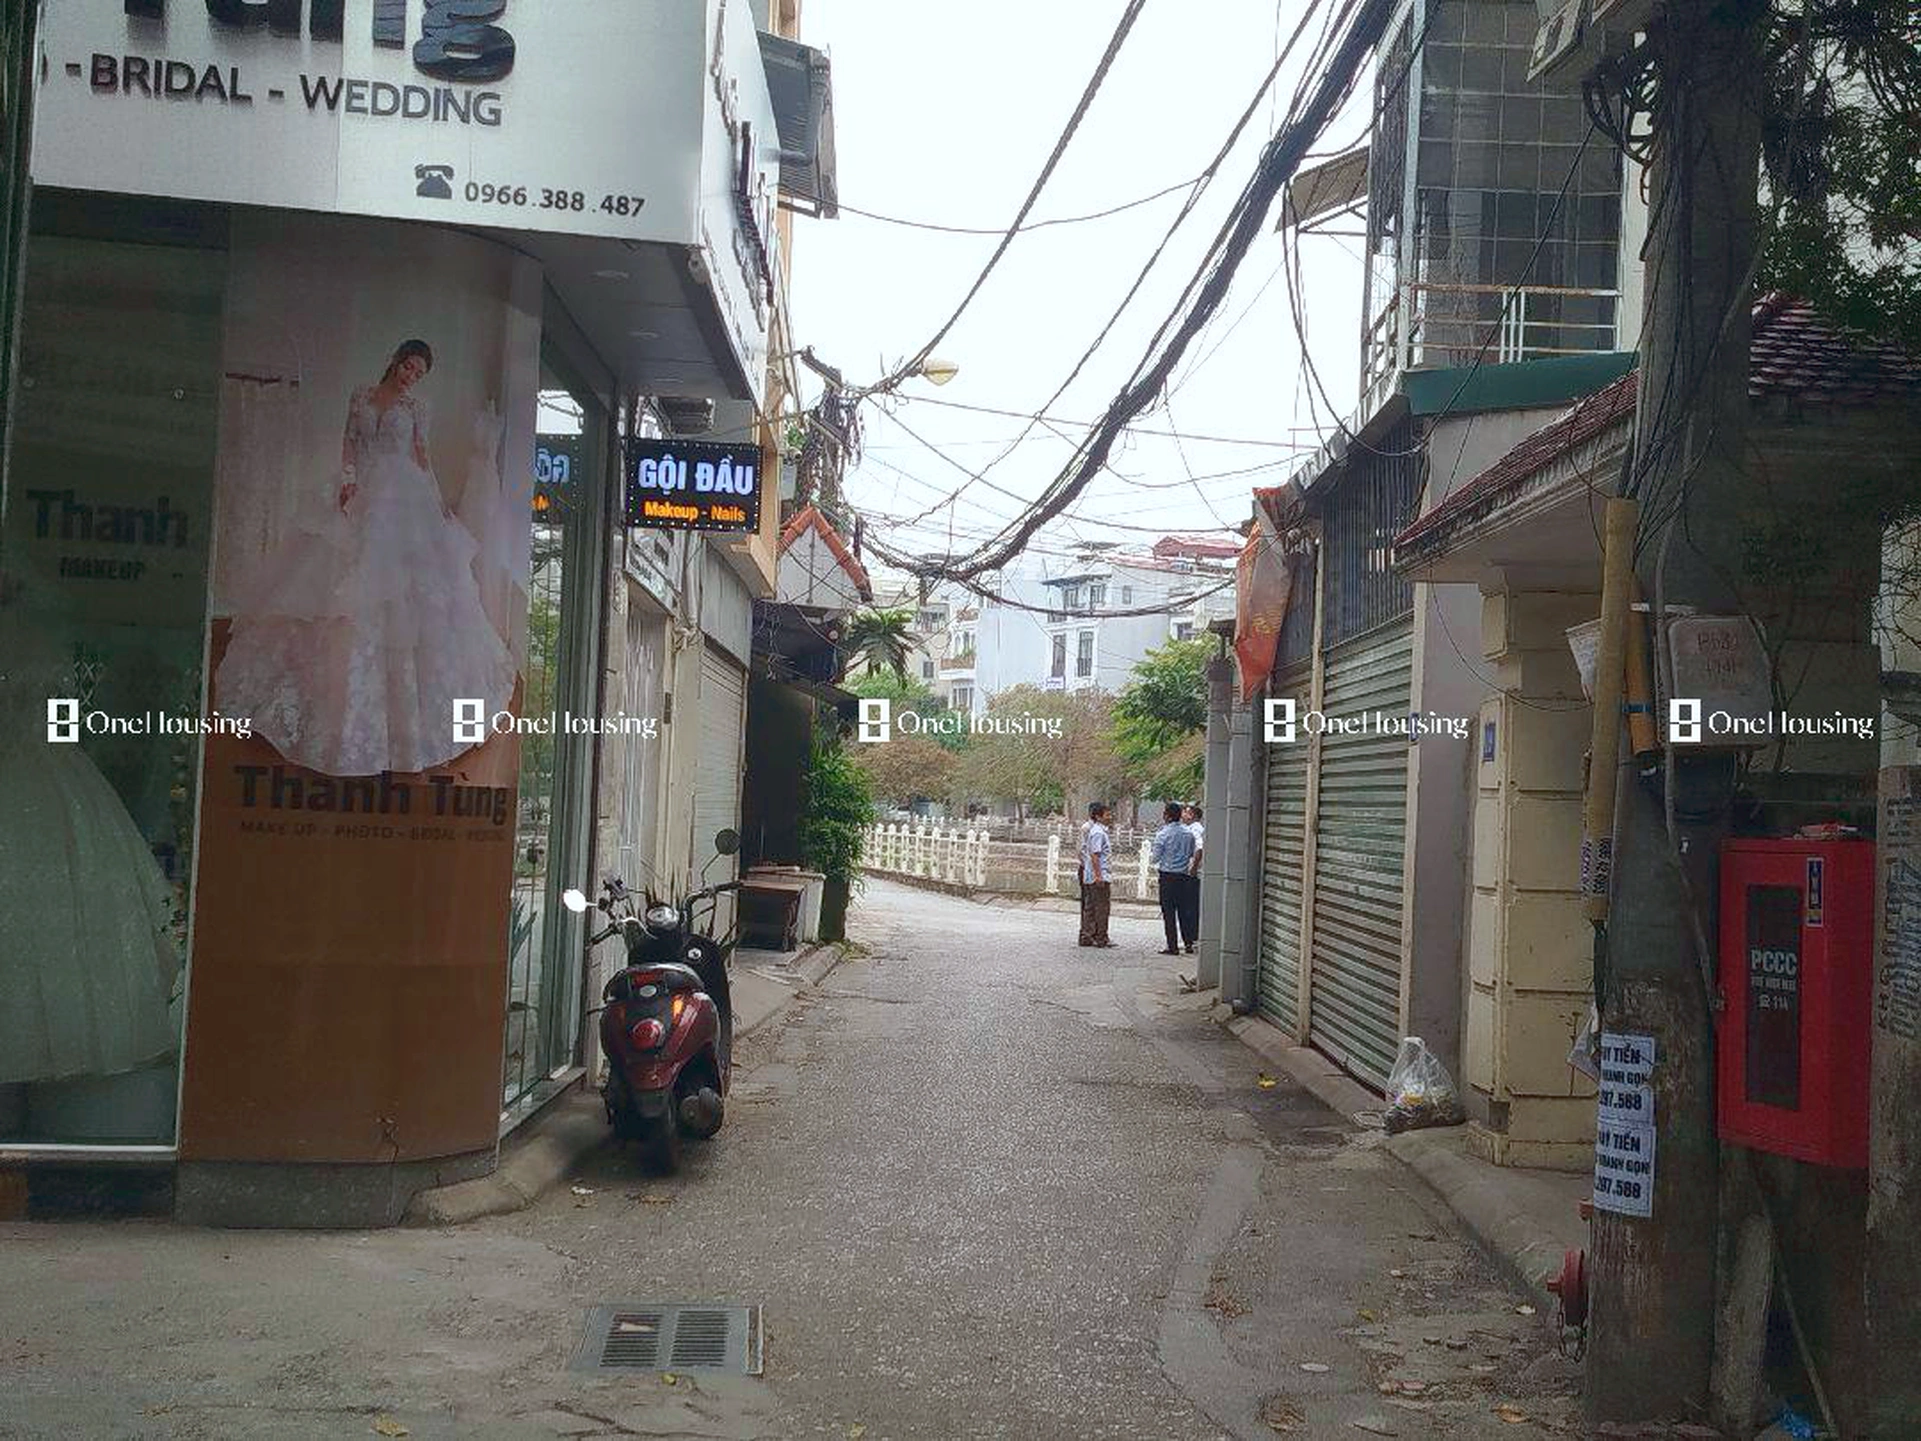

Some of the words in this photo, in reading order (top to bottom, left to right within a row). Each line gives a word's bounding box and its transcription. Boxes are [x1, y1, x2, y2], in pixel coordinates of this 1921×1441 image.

[91, 54, 253, 104] BRIDAL
[300, 74, 502, 126] WEDDING
[465, 181, 646, 217] 0966.388.487
[638, 453, 686, 495] GỘI
[695, 452, 753, 495] ĐẦU
[26, 488, 188, 547] Thanh
[644, 501, 698, 521] Makeup
[711, 505, 746, 522] Nails
[233, 765, 411, 815] Thanh
[428, 771, 509, 826] Tùng
[1750, 949, 1798, 976] PCCC
